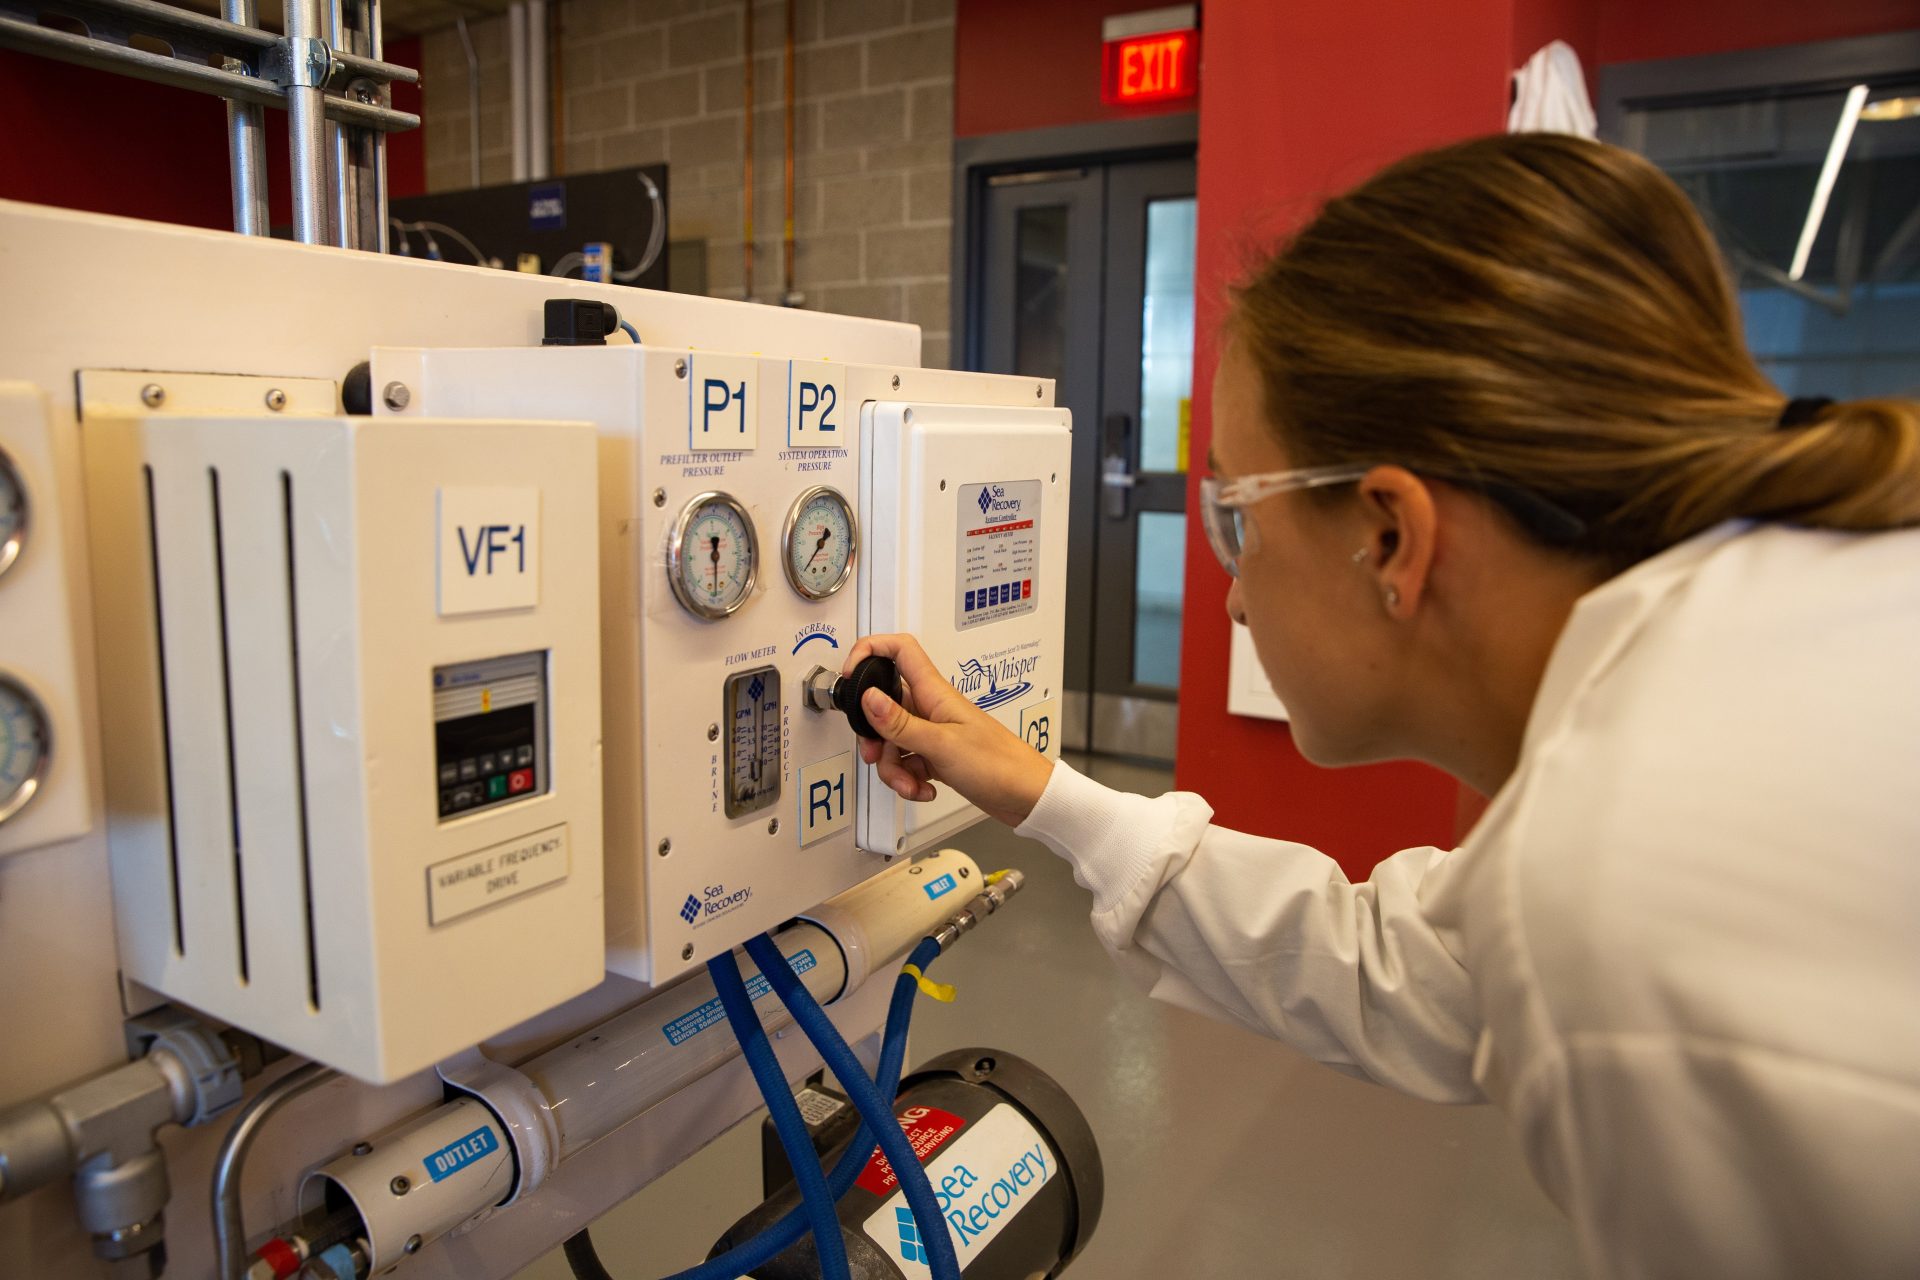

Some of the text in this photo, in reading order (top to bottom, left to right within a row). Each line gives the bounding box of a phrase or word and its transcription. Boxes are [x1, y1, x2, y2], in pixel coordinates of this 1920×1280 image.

[1121, 38, 1182, 96] EXIT
[703, 378, 746, 433] P1
[798, 381, 837, 432] P2
[660, 451, 744, 465] PREFILTER OUTLET
[778, 449, 849, 461] SYSTEM OPERATION
[797, 461, 832, 472] PRESSURE
[682, 465, 725, 478] PRESSURE
[992, 485, 1005, 498] Sea
[992, 499, 1022, 512] Recovery
[456, 524, 525, 576] VF1
[794, 622, 837, 643] INCREASE
[725, 645, 777, 666] FLOW METER
[988, 655, 1039, 686] Whisper
[736, 708, 752, 720] GPM
[763, 700, 777, 711] GPH
[1026, 716, 1049, 753] CB
[809, 773, 845, 829] R1
[437, 836, 561, 888] VARIABLE FREQUENCY
[486, 870, 520, 894] DRIVE
[704, 884, 724, 902] Sea
[704, 886, 751, 917] Recovery
[673, 1027, 697, 1044] RANCHO
[434, 1132, 488, 1173] OUTLET
[915, 1125, 955, 1158] SERVICING
[946, 1143, 1049, 1248] Recovery
